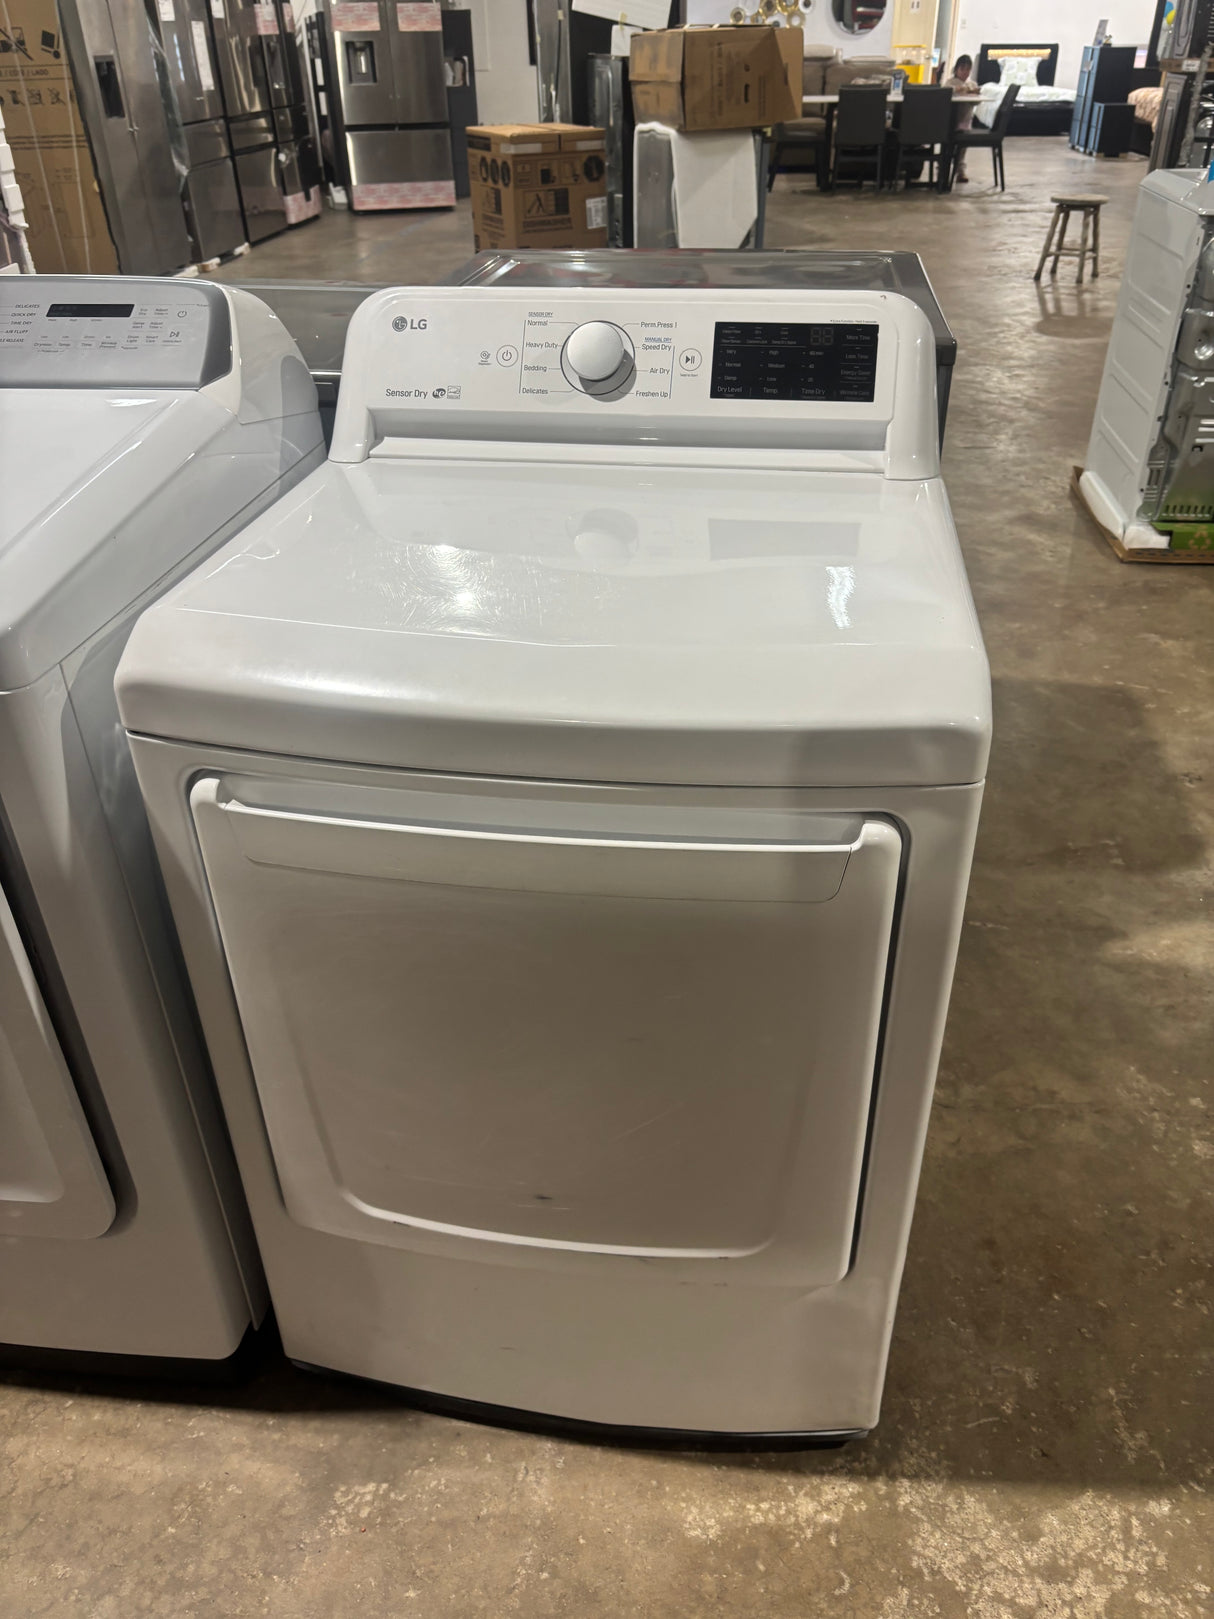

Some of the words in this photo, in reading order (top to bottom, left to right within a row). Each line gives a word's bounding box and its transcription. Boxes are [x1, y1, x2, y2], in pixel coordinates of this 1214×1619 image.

[410, 318, 428, 330] LG
[525, 341, 544, 349] Heavy
[641, 343, 661, 351] Speed
[661, 344, 672, 352] Dry
[523, 365, 548, 373] Bedding
[659, 368, 671, 376] Dry
[386, 388, 412, 398] Sensor
[414, 389, 428, 400] Dry
[522, 387, 549, 395] Delicates
[635, 390, 659, 398] Freshen
[660, 391, 669, 399] Up
